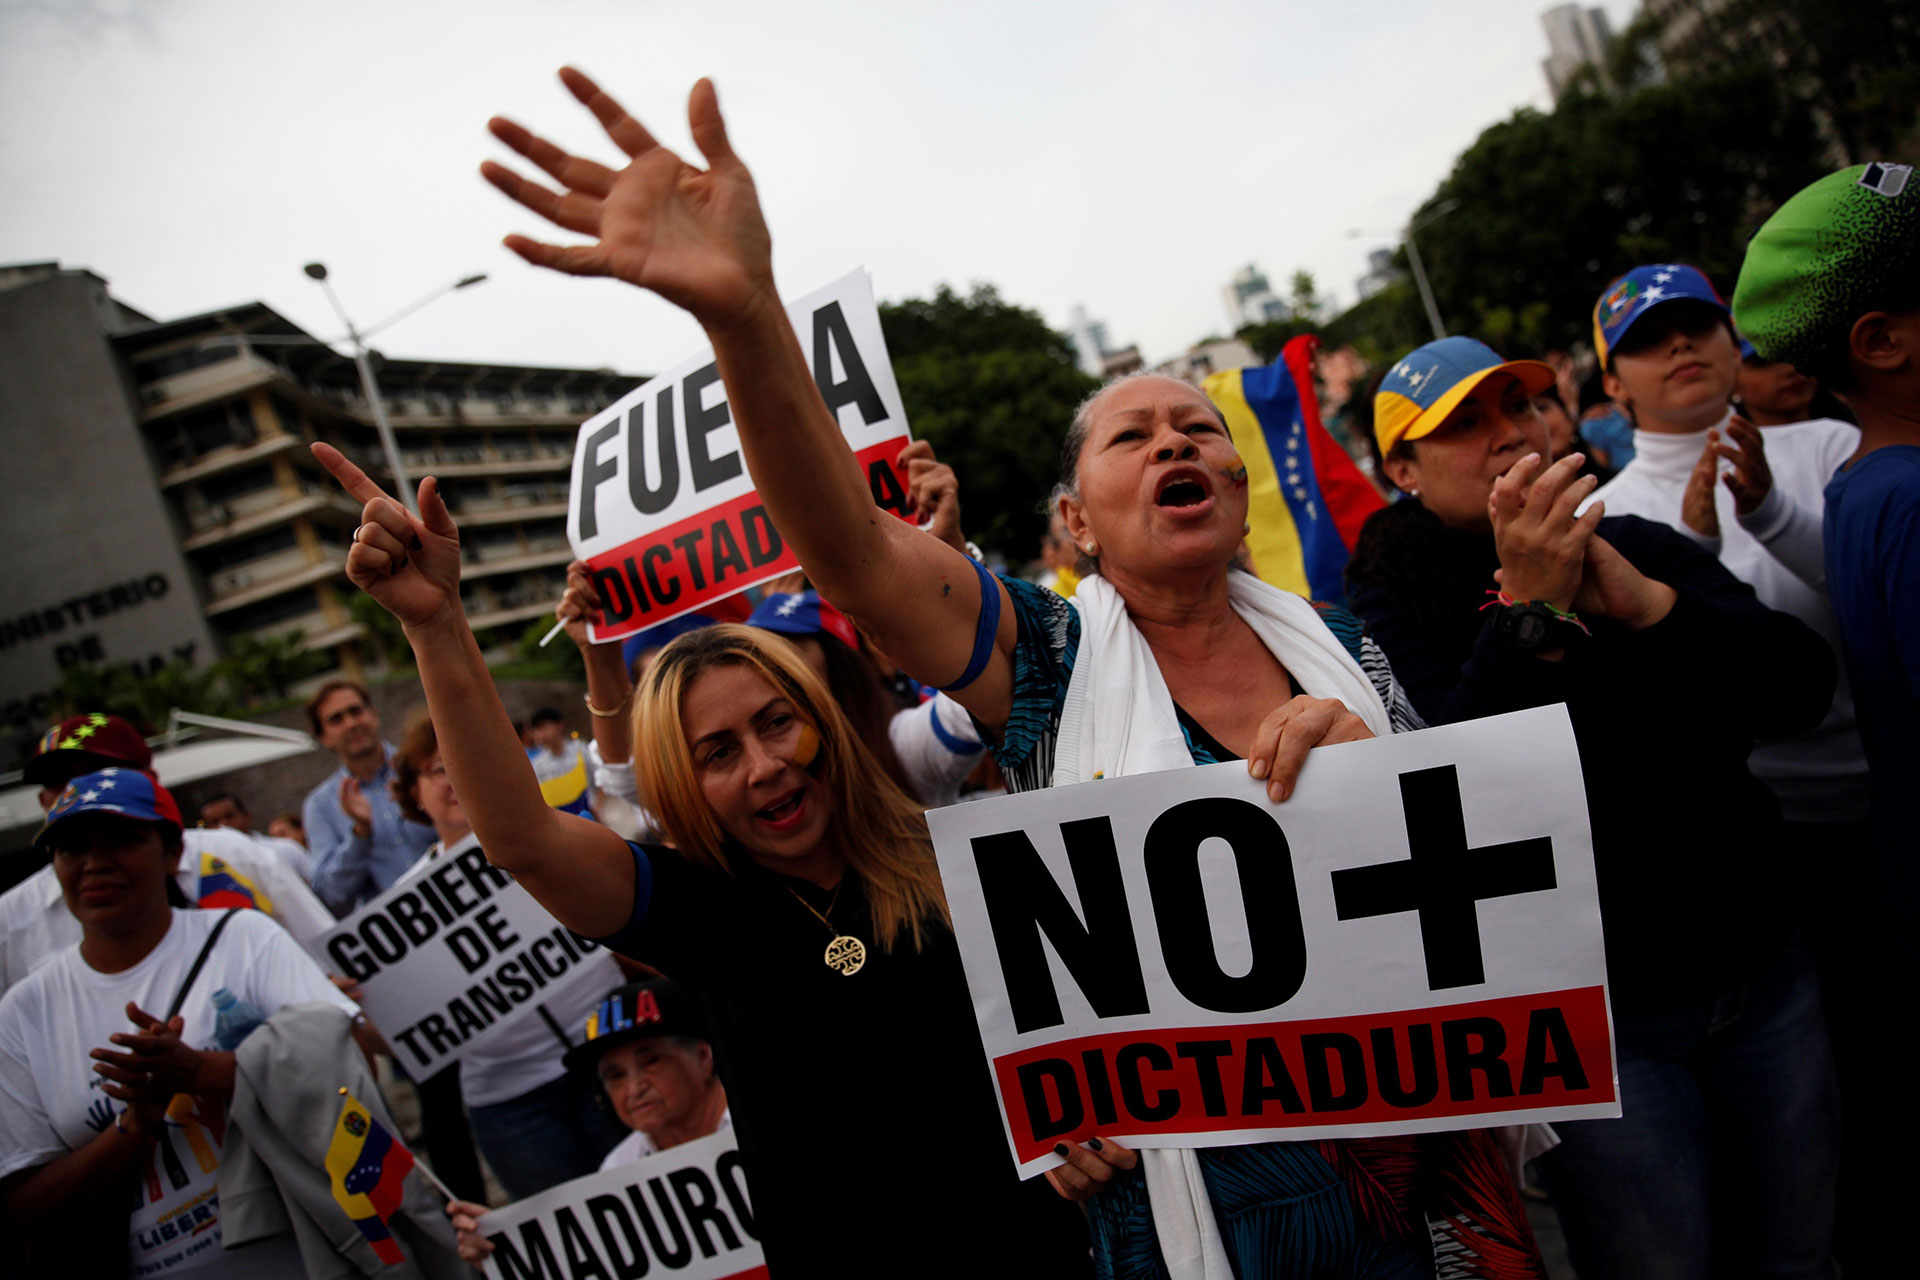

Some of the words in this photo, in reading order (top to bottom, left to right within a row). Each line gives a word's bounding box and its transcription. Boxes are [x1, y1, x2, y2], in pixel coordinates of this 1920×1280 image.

[579, 300, 890, 542] FUEA
[592, 459, 914, 627] DICTADA
[327, 846, 510, 984] GOBIER
[443, 904, 520, 976] DE
[1016, 1006, 1590, 1143] DICTADURA
[486, 1149, 761, 1280] MADURO
